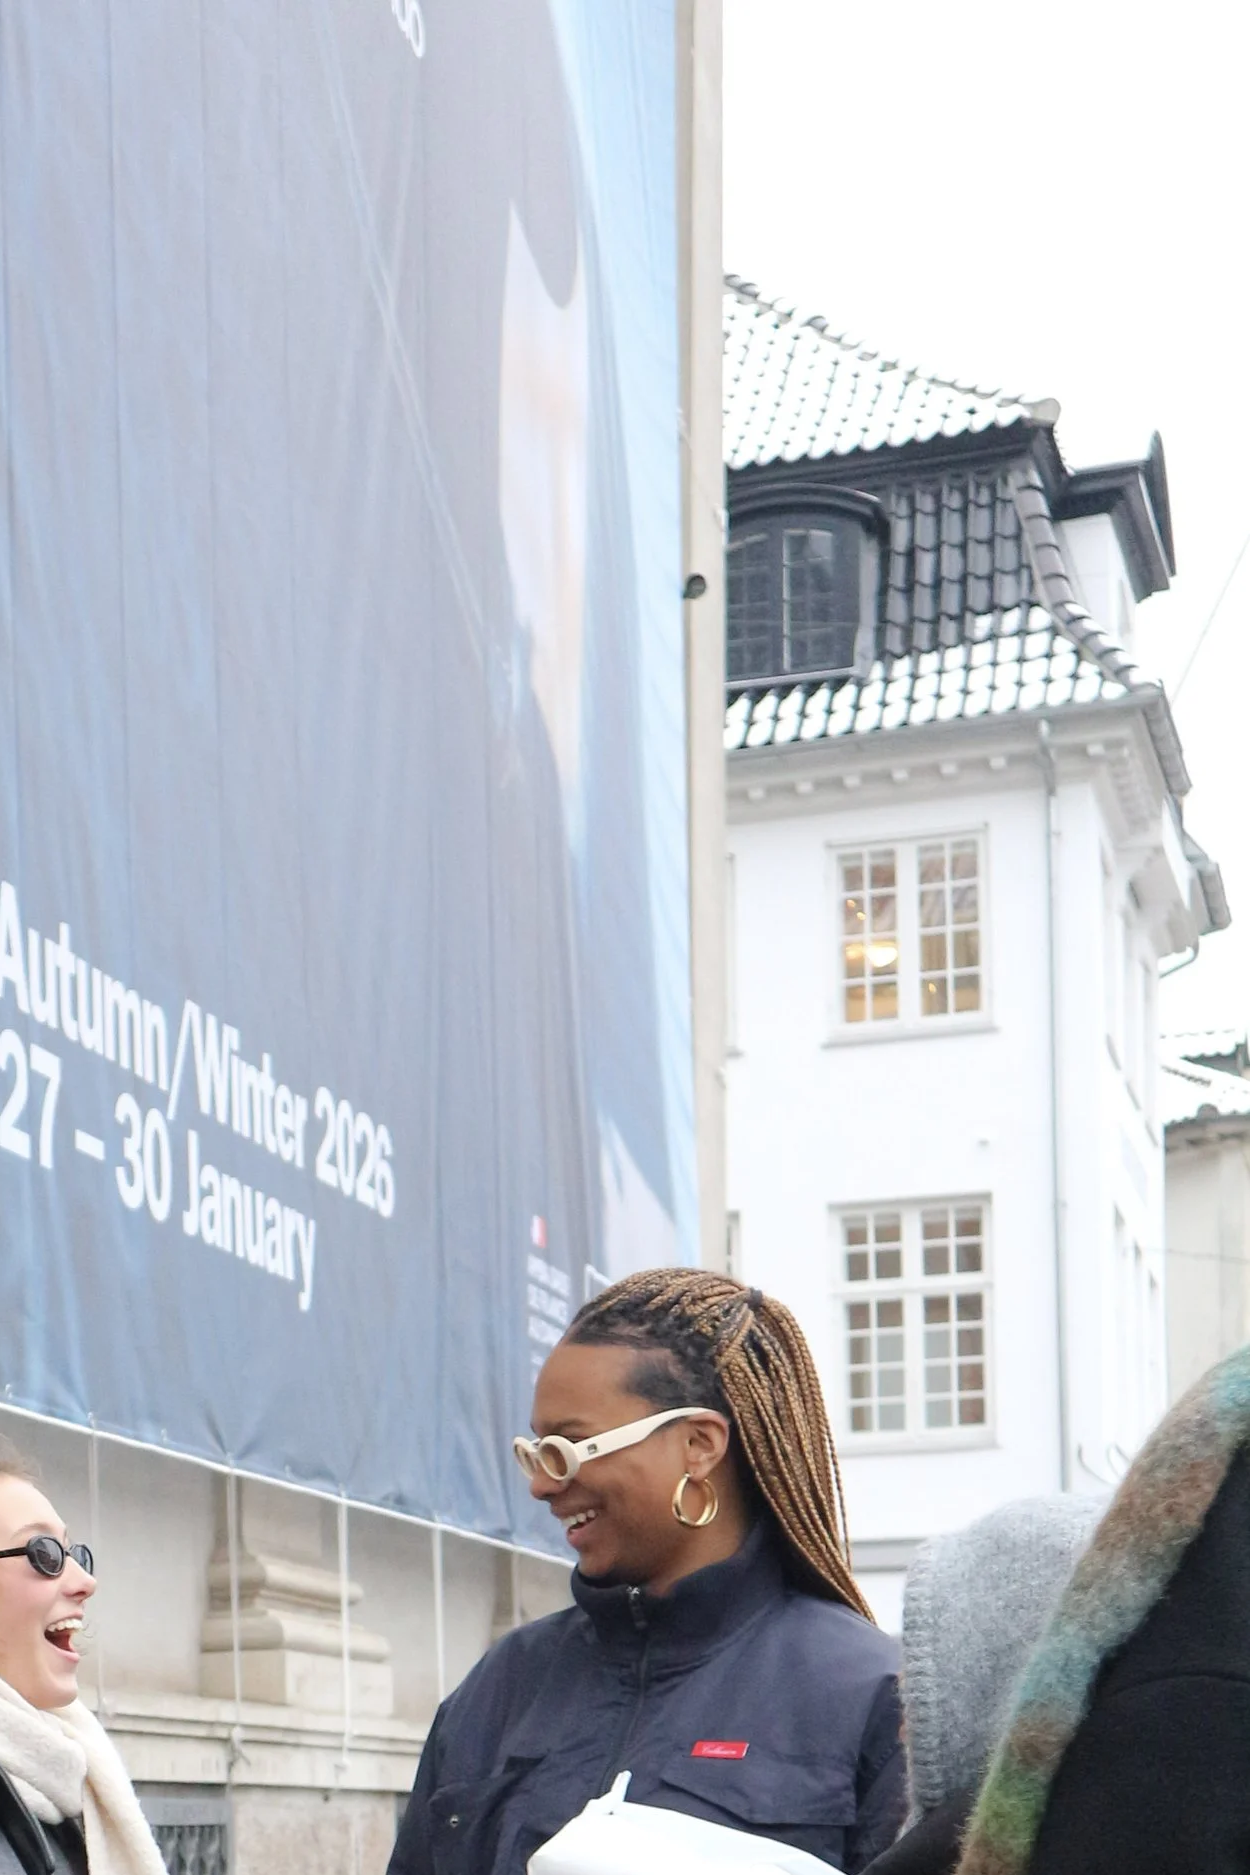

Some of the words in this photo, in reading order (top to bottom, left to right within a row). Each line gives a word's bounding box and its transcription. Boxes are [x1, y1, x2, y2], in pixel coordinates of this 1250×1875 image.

[114, 1092, 172, 1222] 30
[182, 1129, 316, 1312] January
[314, 1086, 395, 1219] 2026
